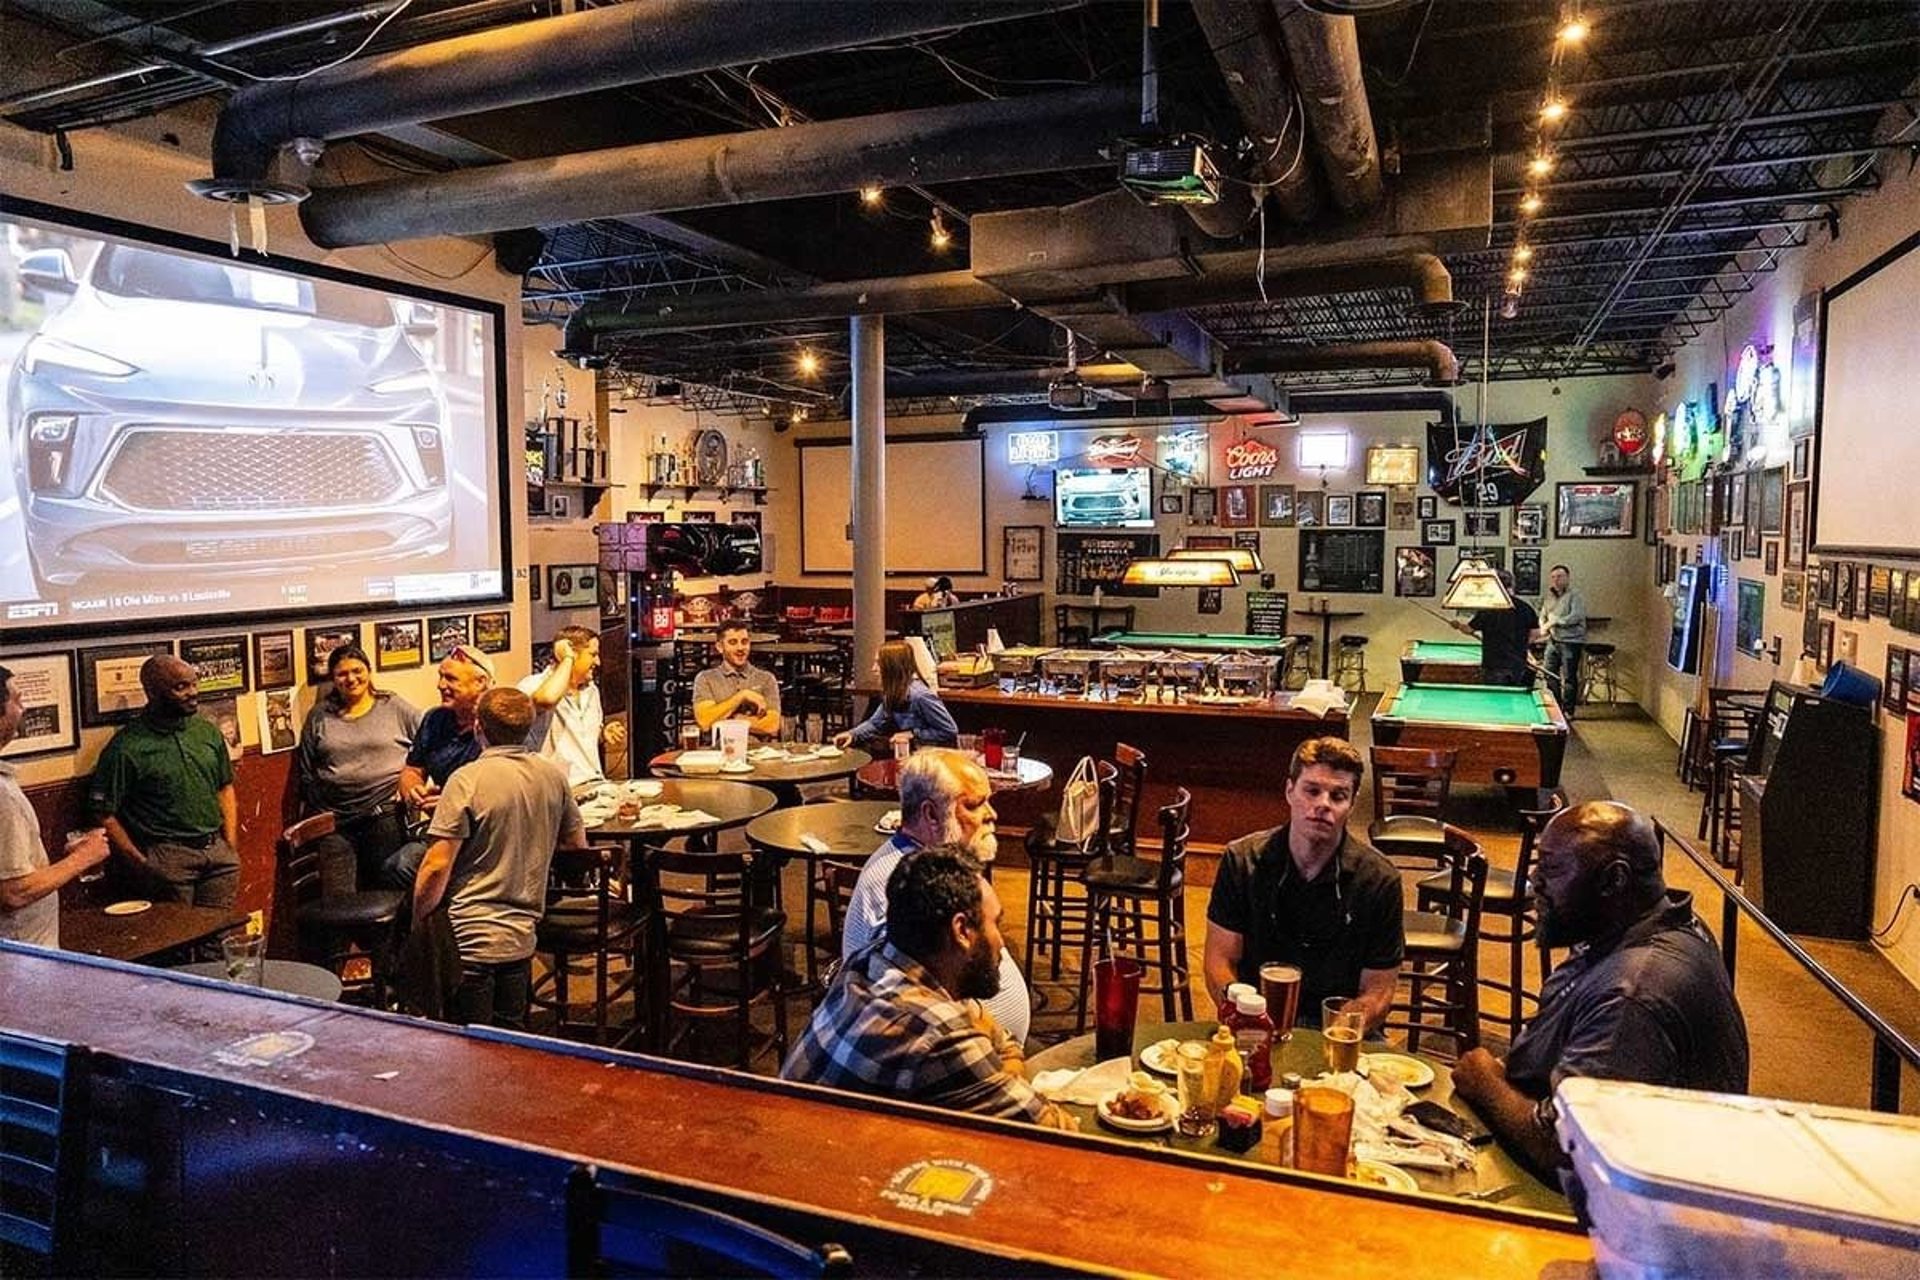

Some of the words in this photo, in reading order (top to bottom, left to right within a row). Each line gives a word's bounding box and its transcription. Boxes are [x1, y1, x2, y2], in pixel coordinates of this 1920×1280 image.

[1226, 445, 1278, 467] Coors
[1445, 434, 1521, 476] Bud
[1230, 464, 1275, 479] LIGHT
[1476, 482, 1498, 501] 29
[7, 602, 59, 619] ESPN
